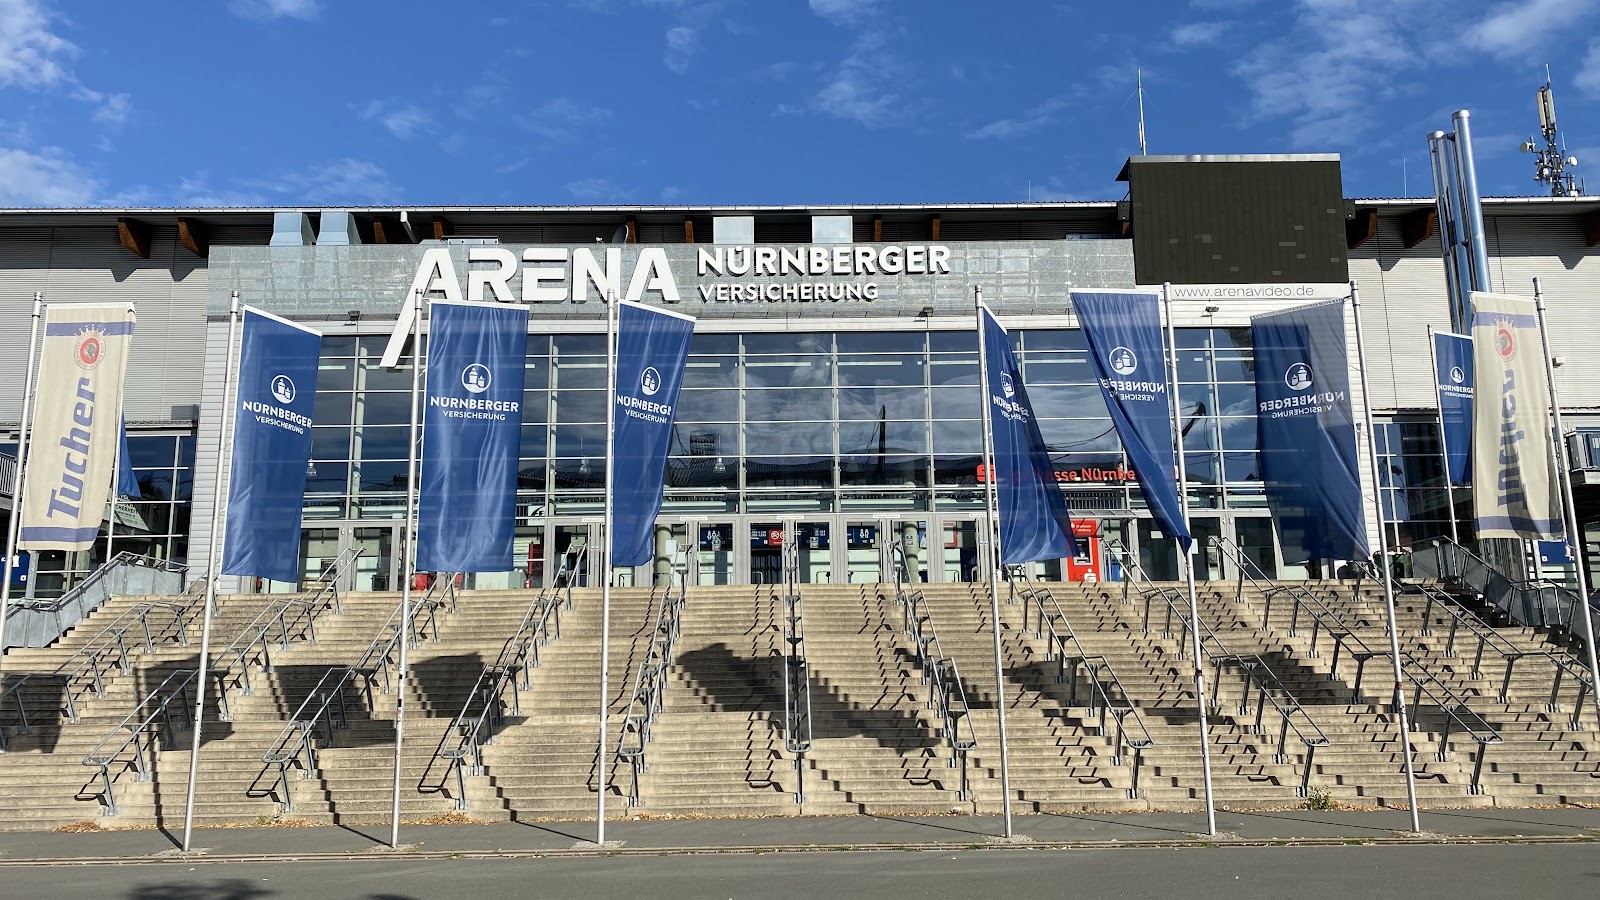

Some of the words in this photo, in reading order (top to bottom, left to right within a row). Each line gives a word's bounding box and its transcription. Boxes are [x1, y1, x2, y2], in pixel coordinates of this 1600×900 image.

[698, 244, 952, 276] NÜRNBERGER
[699, 282, 879, 303] VERSICHERUNG
[1174, 285, 1315, 298] www.arenavideo.de
[379, 247, 681, 368] ARENA
[1438, 384, 1474, 394] NÜRNBERGE
[430, 395, 519, 412] NÜRNBERGER
[242, 400, 313, 429] NÜRNBERGER
[442, 410, 506, 421] VERSICHERUNG
[255, 415, 305, 435] VERSICHERUNG
[47, 376, 96, 520] Tucher
[1081, 466, 1136, 482] Nürnbe
